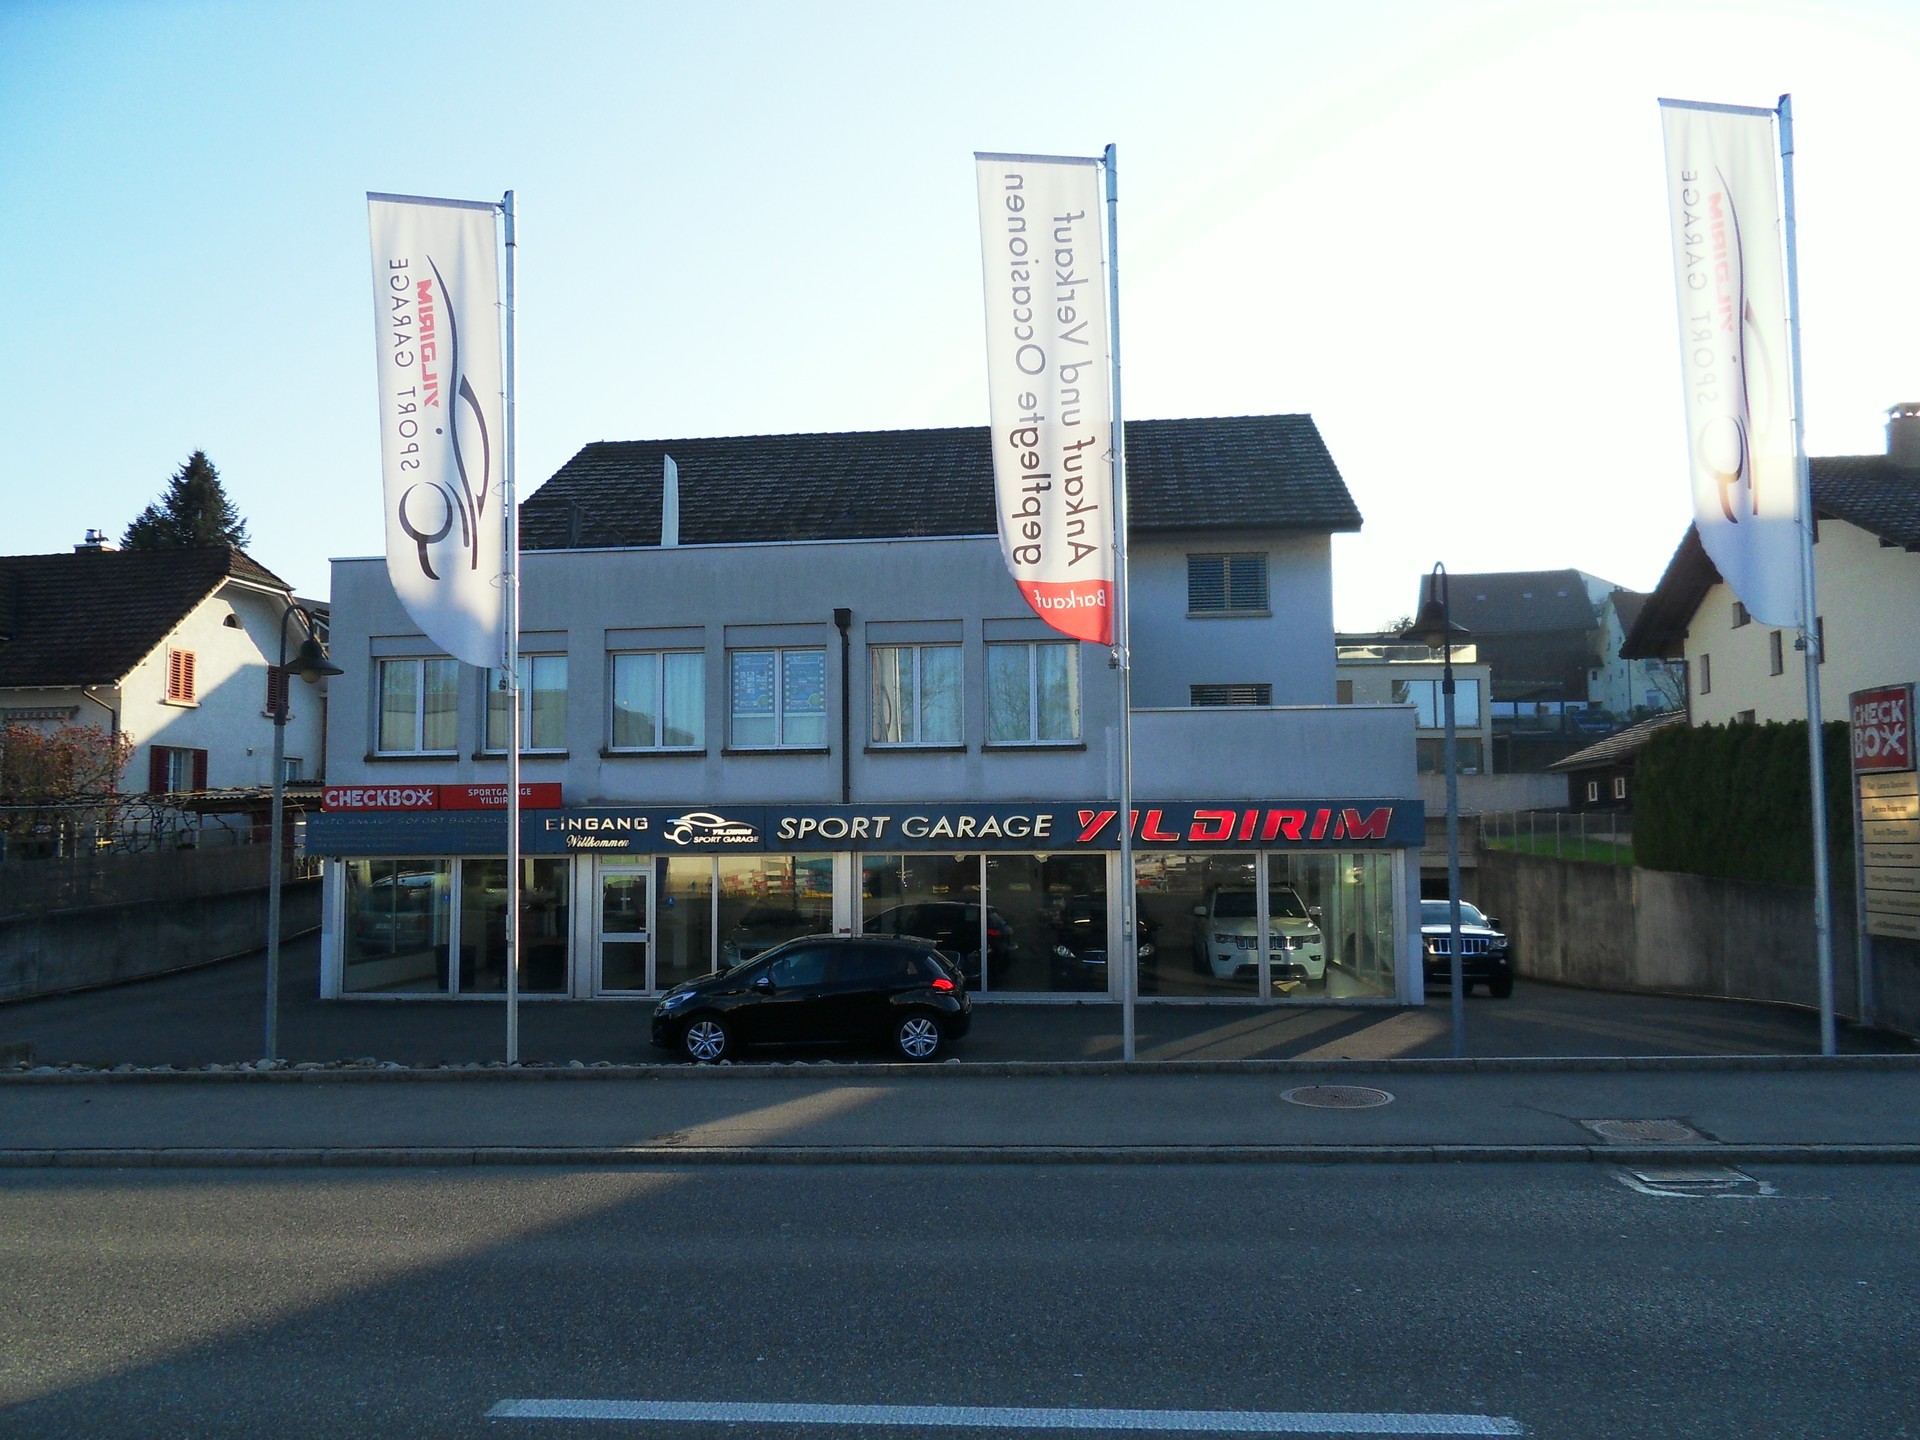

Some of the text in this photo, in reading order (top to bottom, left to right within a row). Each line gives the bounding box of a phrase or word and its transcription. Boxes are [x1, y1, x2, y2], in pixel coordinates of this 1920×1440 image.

[1853, 700, 1905, 726] CHECK
[1853, 723, 1906, 758] BOX
[325, 788, 434, 807] CHECKBOX
[468, 787, 532, 797] SPORTGAGE
[479, 796, 509, 805] YILDIR
[447, 816, 530, 825] BARZAHLUG
[776, 815, 891, 840] SPORT
[901, 814, 1054, 838] GARAGE
[566, 834, 631, 849] Willkommen
[693, 835, 759, 844] SPORT GARAGE
